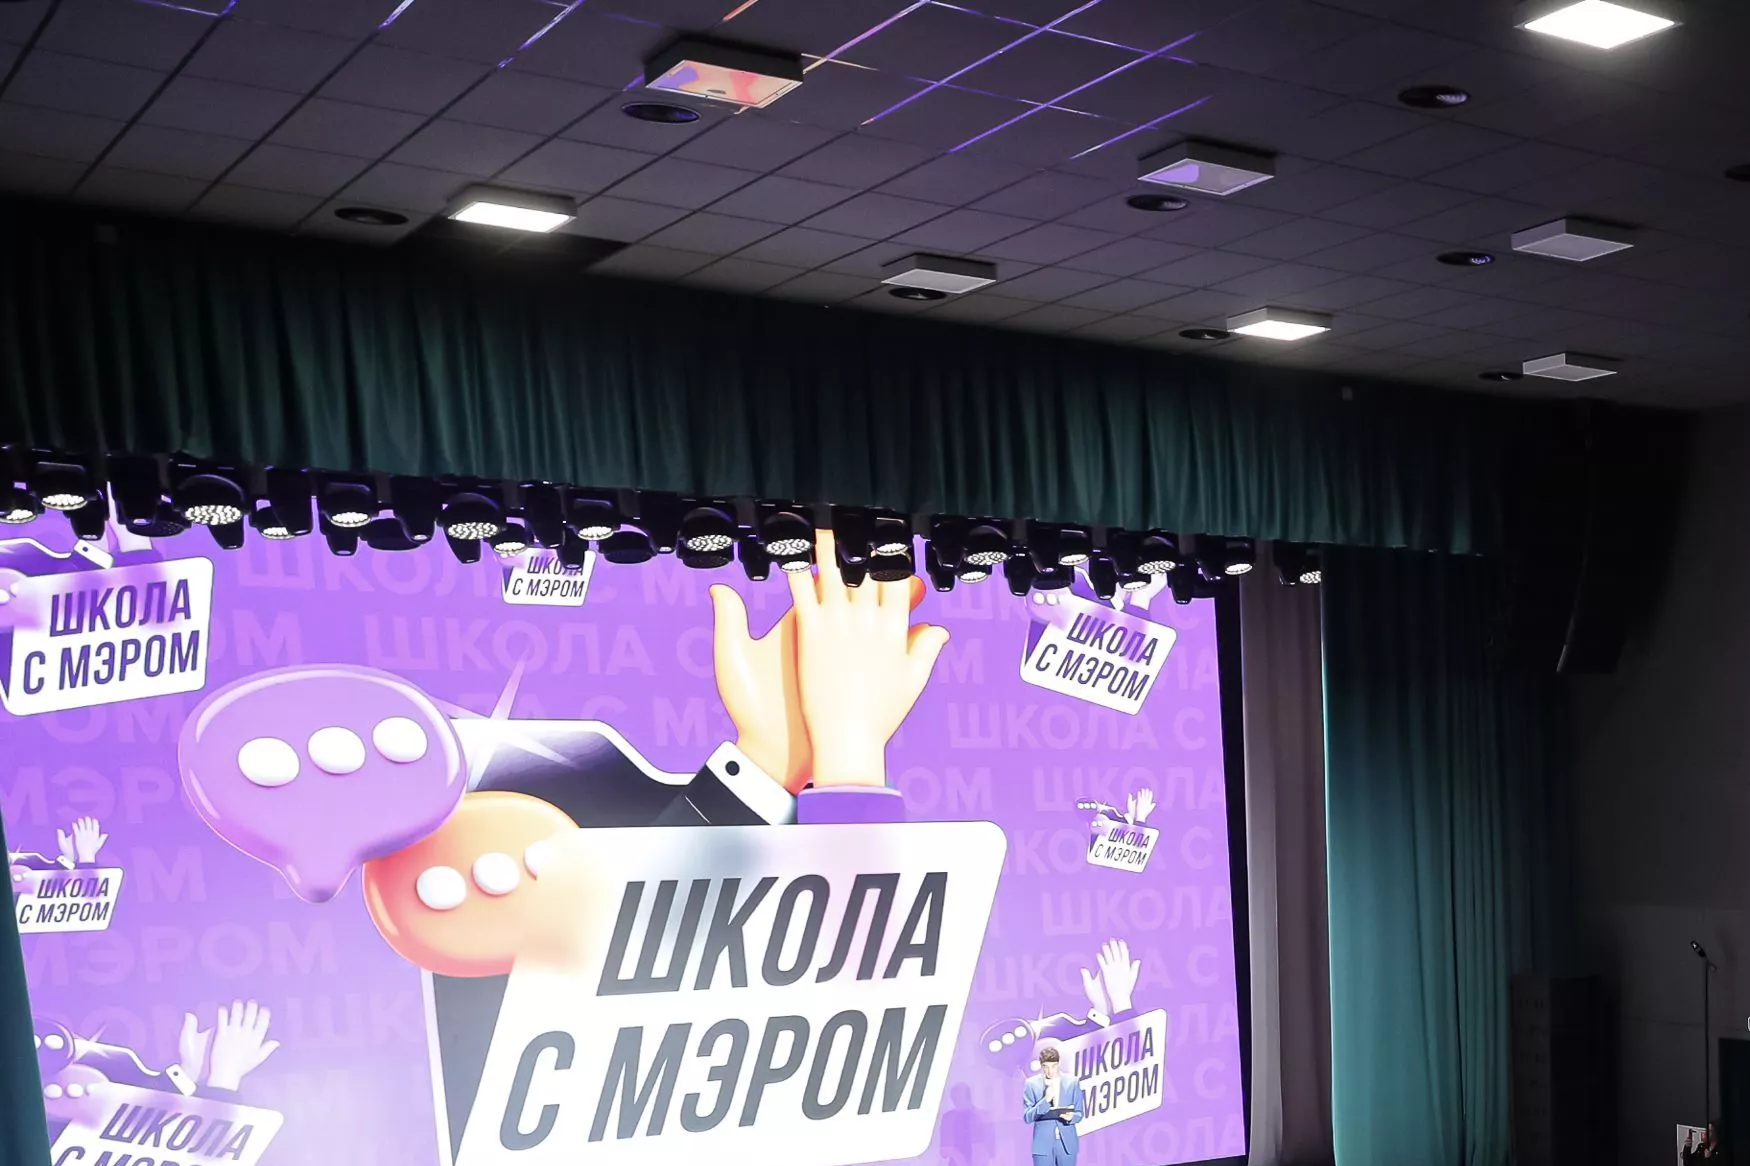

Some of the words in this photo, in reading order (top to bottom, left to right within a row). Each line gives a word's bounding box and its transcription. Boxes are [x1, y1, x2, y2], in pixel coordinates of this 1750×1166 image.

[237, 539, 500, 597] ШКОЛ
[512, 578, 523, 596] С
[526, 578, 585, 598] МЭРОМ
[49, 579, 192, 637] ШКОЛА
[23, 651, 47, 694] С
[57, 631, 200, 691] МЭРОМ
[1066, 613, 1158, 665] ШКОЛА
[1036, 643, 1058, 671] С
[1057, 648, 1149, 700] МЭРОМ
[1094, 843, 1104, 858] С
[1104, 846, 1147, 865] МЭРОМ
[1108, 828, 1150, 848] ШКОЛА
[19, 904, 33, 924] С
[36, 901, 110, 923] МЭРОМ
[37, 877, 109, 899] ШКОЛА
[595, 871, 948, 997] ШКОЛА
[499, 1029, 577, 1151] С
[588, 1003, 948, 1143] МЭРОМ
[1074, 1027, 1154, 1081] ШКОЛА
[99, 1102, 254, 1161] ШКОЛА
